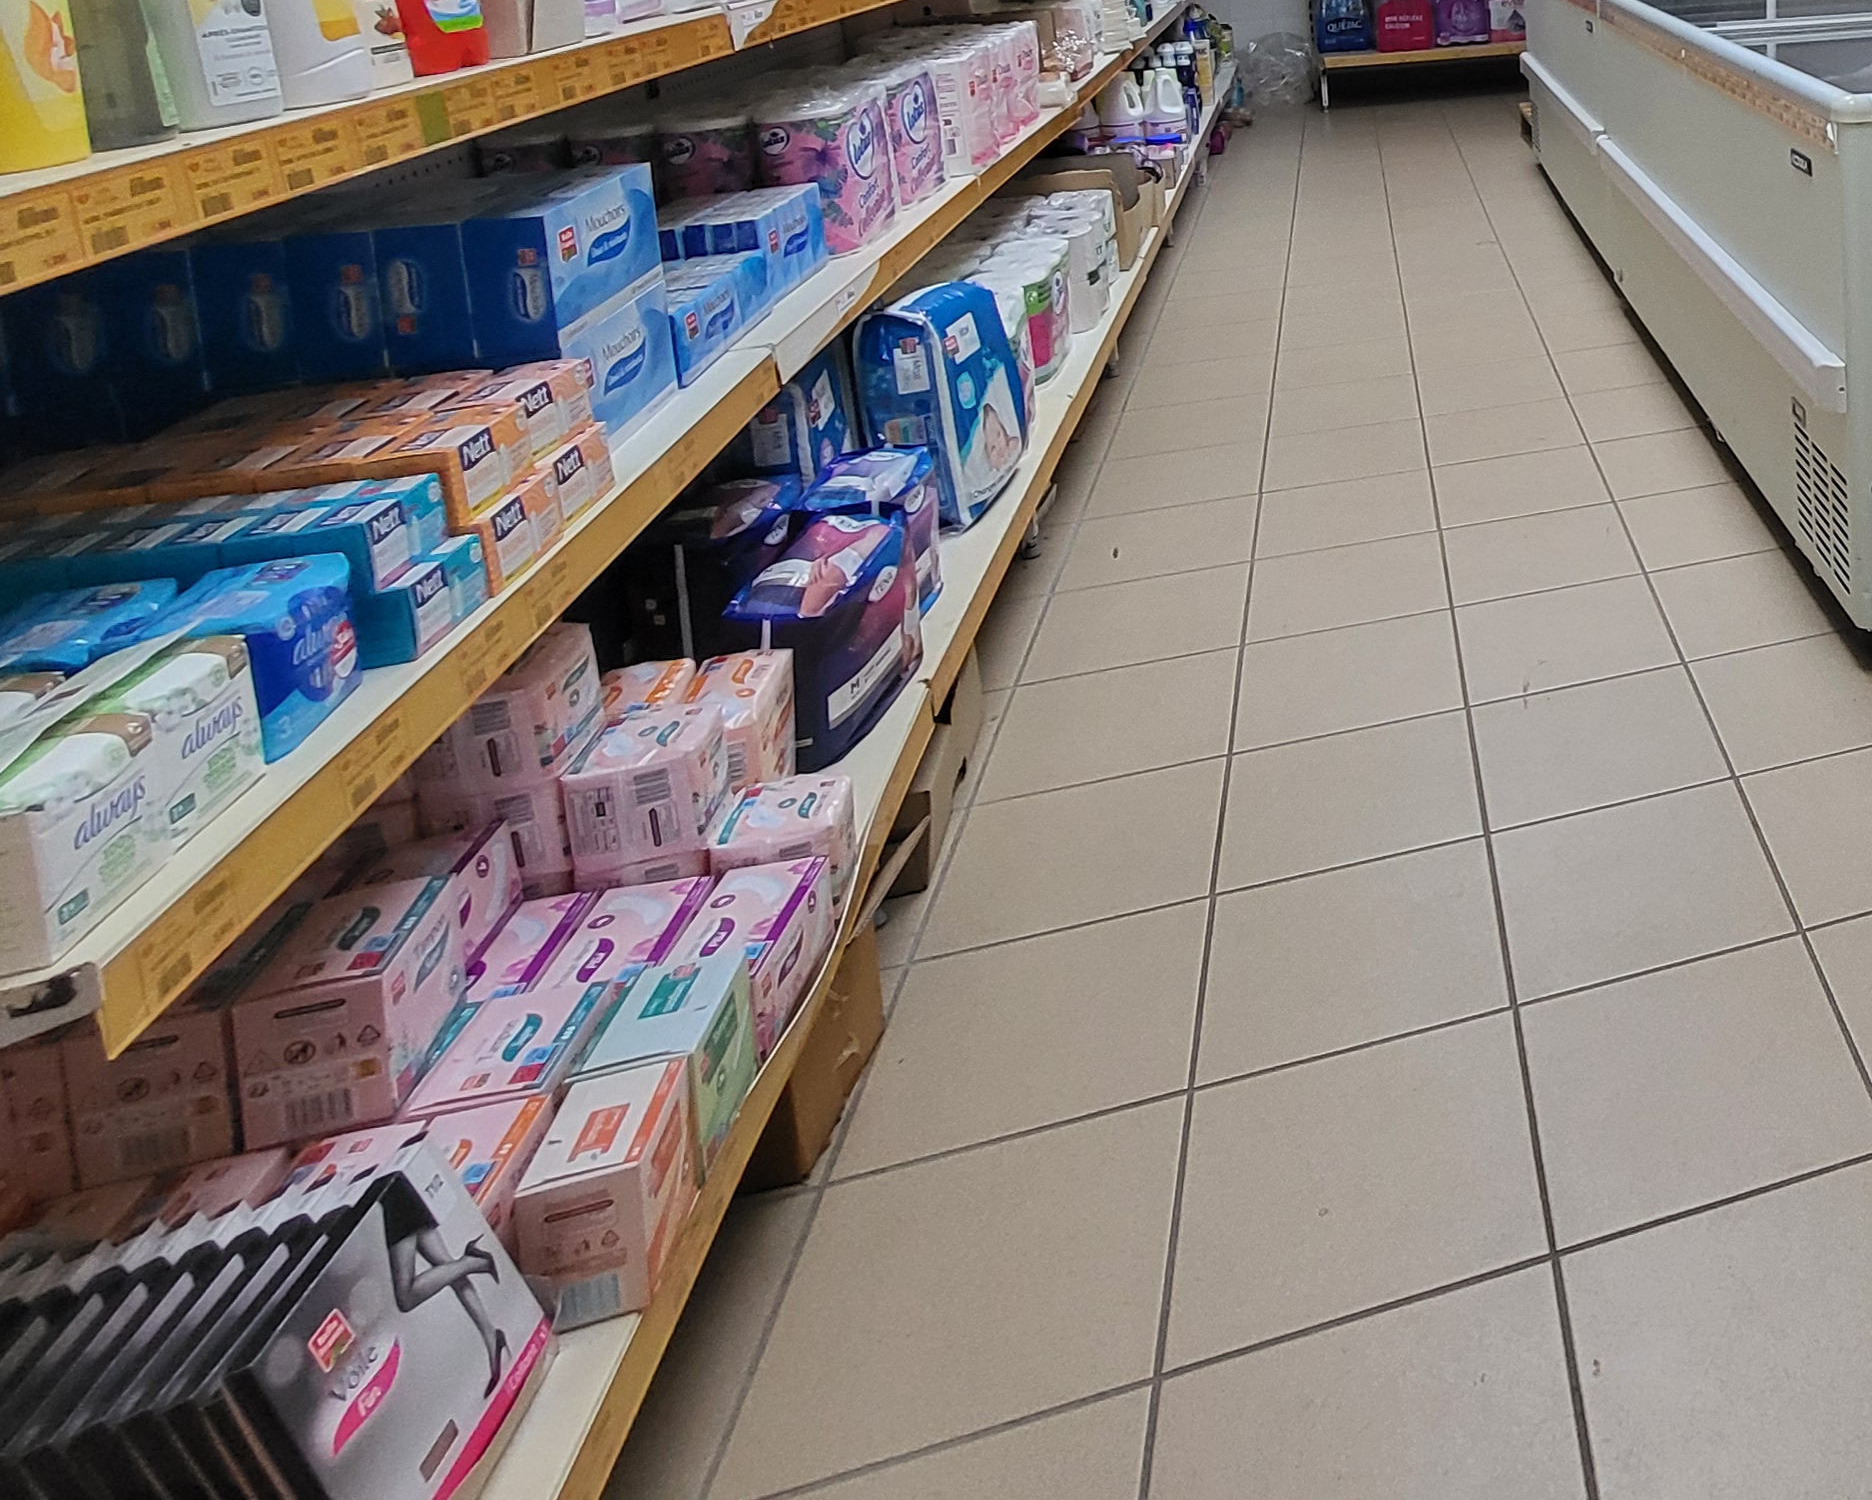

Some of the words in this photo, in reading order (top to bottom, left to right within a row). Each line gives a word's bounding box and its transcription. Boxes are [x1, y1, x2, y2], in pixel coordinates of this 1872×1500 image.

[585, 203, 625, 232] Mouchoirs
[602, 325, 641, 360] Mouchoirs
[520, 385, 551, 414] Nett
[462, 432, 492, 469] Nett
[556, 449, 583, 482] Nett
[371, 506, 401, 542] Nett
[495, 501, 524, 538] Nett
[415, 569, 445, 605] Nett
[850, 680, 860, 693] M
[181, 695, 244, 760] always
[75, 775, 146, 850] always
